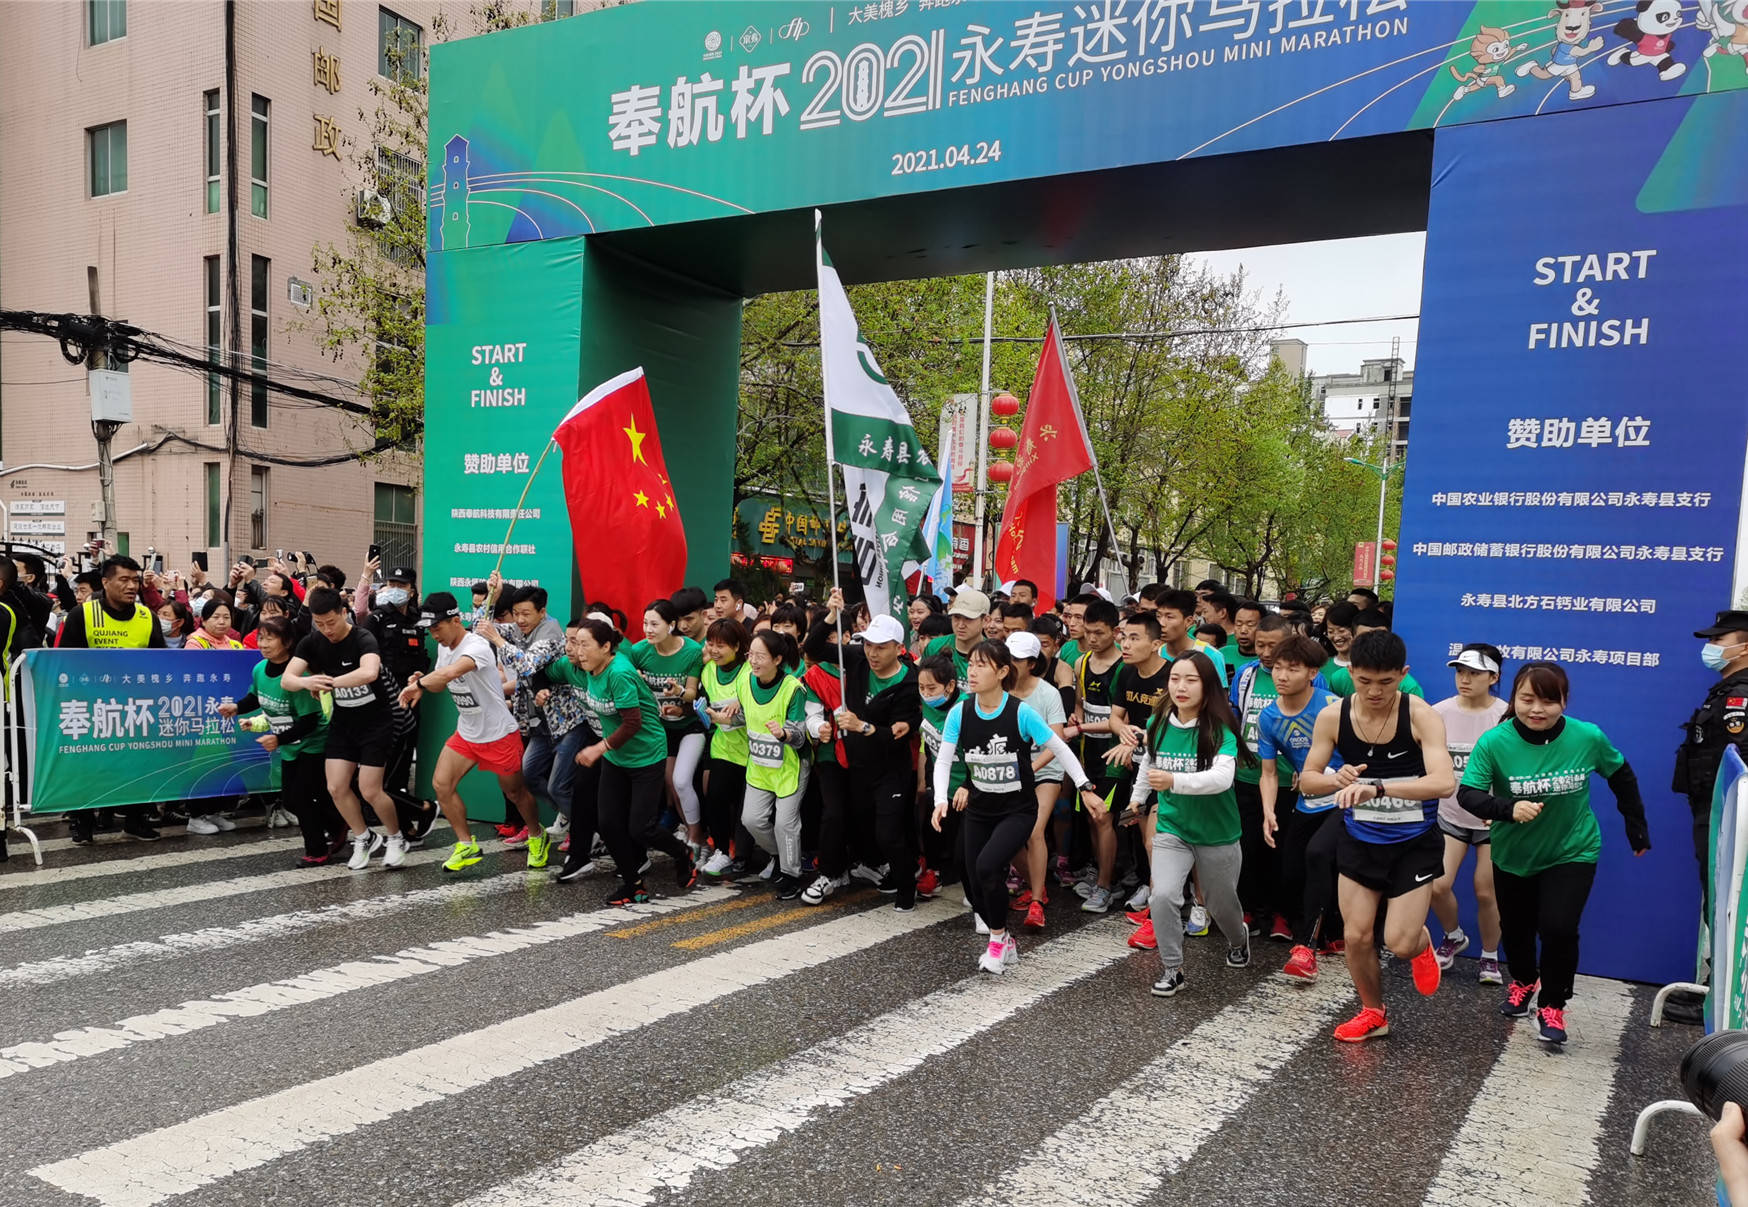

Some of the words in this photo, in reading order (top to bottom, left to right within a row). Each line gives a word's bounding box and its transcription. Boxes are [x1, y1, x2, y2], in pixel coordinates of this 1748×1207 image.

[948, 75, 1049, 108] FENGHANG
[1054, 69, 1094, 92] CUP
[1100, 49, 1216, 83] YONGSHOU
[1223, 38, 1273, 65] MINI
[1280, 16, 1409, 55] MARATHON
[607, 62, 791, 157] 奉航杯
[800, 28, 945, 131] 2021
[890, 139, 1002, 176] 2021.04.24
[1533, 249, 1657, 286] START
[1571, 287, 1600, 316] &
[1528, 318, 1649, 349] FINISH
[471, 342, 527, 366] START
[489, 367, 503, 386] &
[471, 388, 526, 408] FINISH
[1506, 416, 1651, 449] 赞助单位
[464, 453, 530, 475] 赞助单位
[1431, 491, 1711, 508] 中国农业银行股份有限公司永寿县支行
[1413, 541, 1724, 562] 中国邮政储蓄银行股份有限公司永寿县支行
[1461, 592, 1656, 614] 永寿县北方石钙业有限公司
[93, 630, 128, 638] QUJIANG
[1448, 642, 1660, 667] 温牧有限公司永寿项目部
[334, 684, 369, 699] A0133
[59, 697, 155, 741] 奉航杯
[157, 696, 202, 719] 2021
[158, 717, 236, 737] 迷你马拉松
[59, 744, 107, 754] FENGHANG
[108, 743, 126, 752] CUP
[128, 740, 173, 750] YONGSHOU
[175, 739, 193, 748] MINI
[195, 736, 237, 747] MARATHON
[973, 765, 1015, 781] A0878
[1510, 778, 1552, 795] 奉航杯
